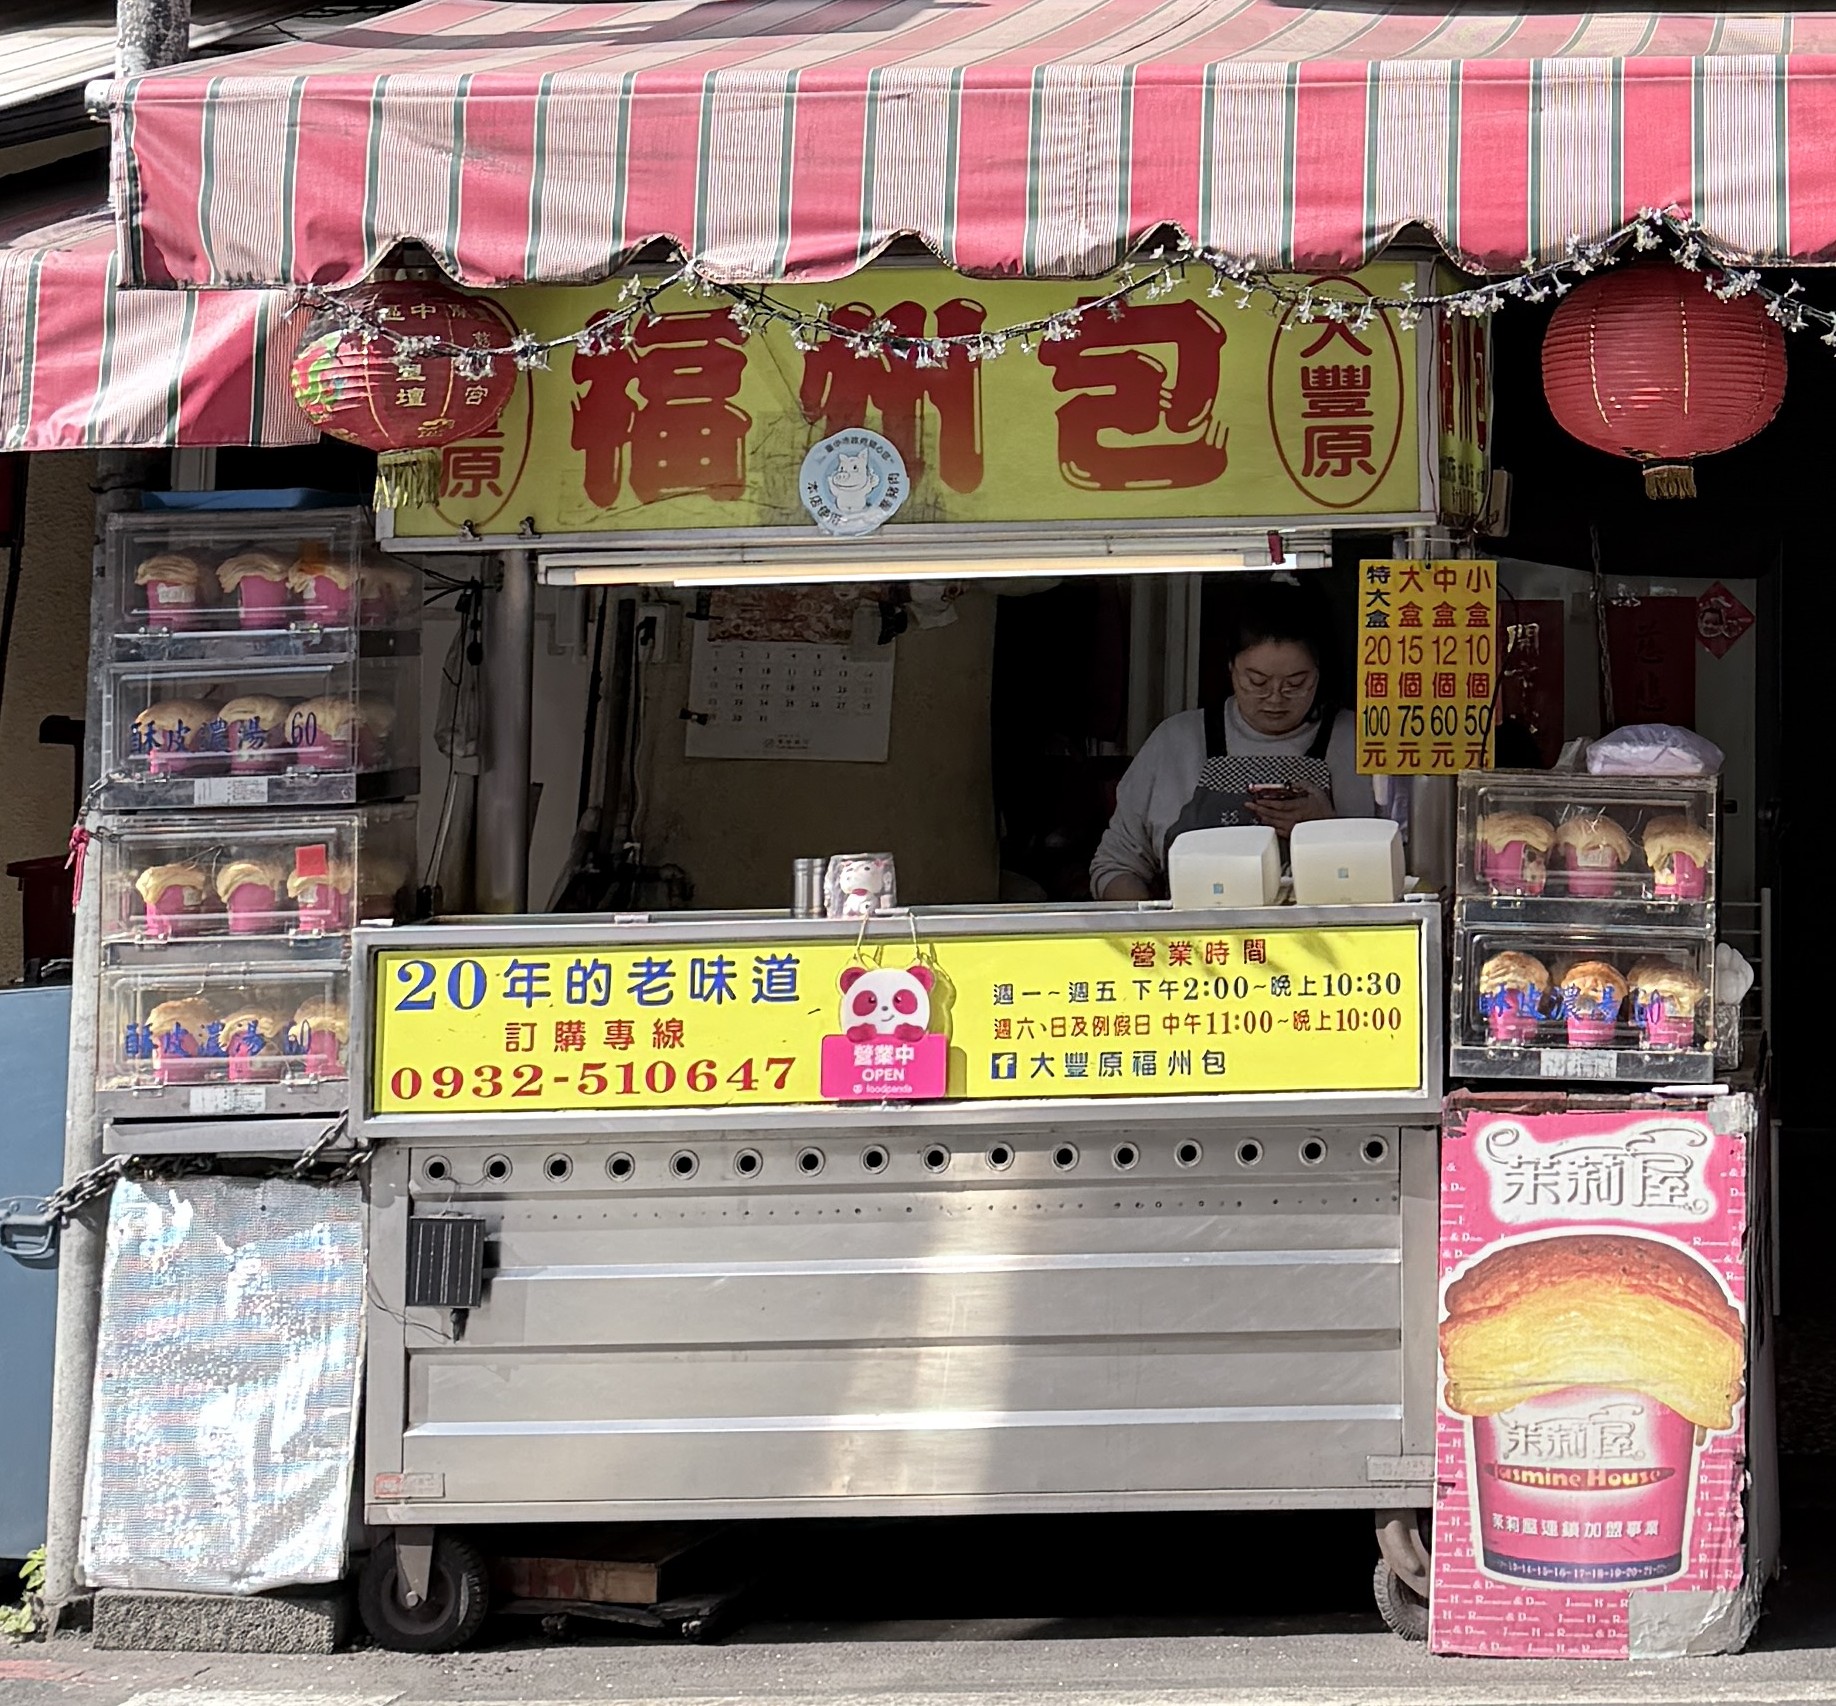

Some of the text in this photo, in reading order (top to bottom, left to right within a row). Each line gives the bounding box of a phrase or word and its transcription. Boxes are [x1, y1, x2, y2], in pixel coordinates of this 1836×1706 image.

[569, 297, 1230, 509] 福州包
[1299, 300, 1374, 479] 大豐原
[130, 711, 317, 753] 酥皮濃湯 60
[1130, 938, 1268, 968] 營業時間
[394, 952, 801, 1012] 20年的老味道
[504, 1017, 686, 1053] 訂購專線
[853, 1043, 915, 1067] 營業中
[1030, 1048, 1227, 1079] 大豐原福州包
[390, 1056, 797, 1101] 0932-510647
[861, 1068, 905, 1082] OPEN
[865, 1084, 913, 1094] foodpanda
[1587, 1466, 1661, 1488] House
